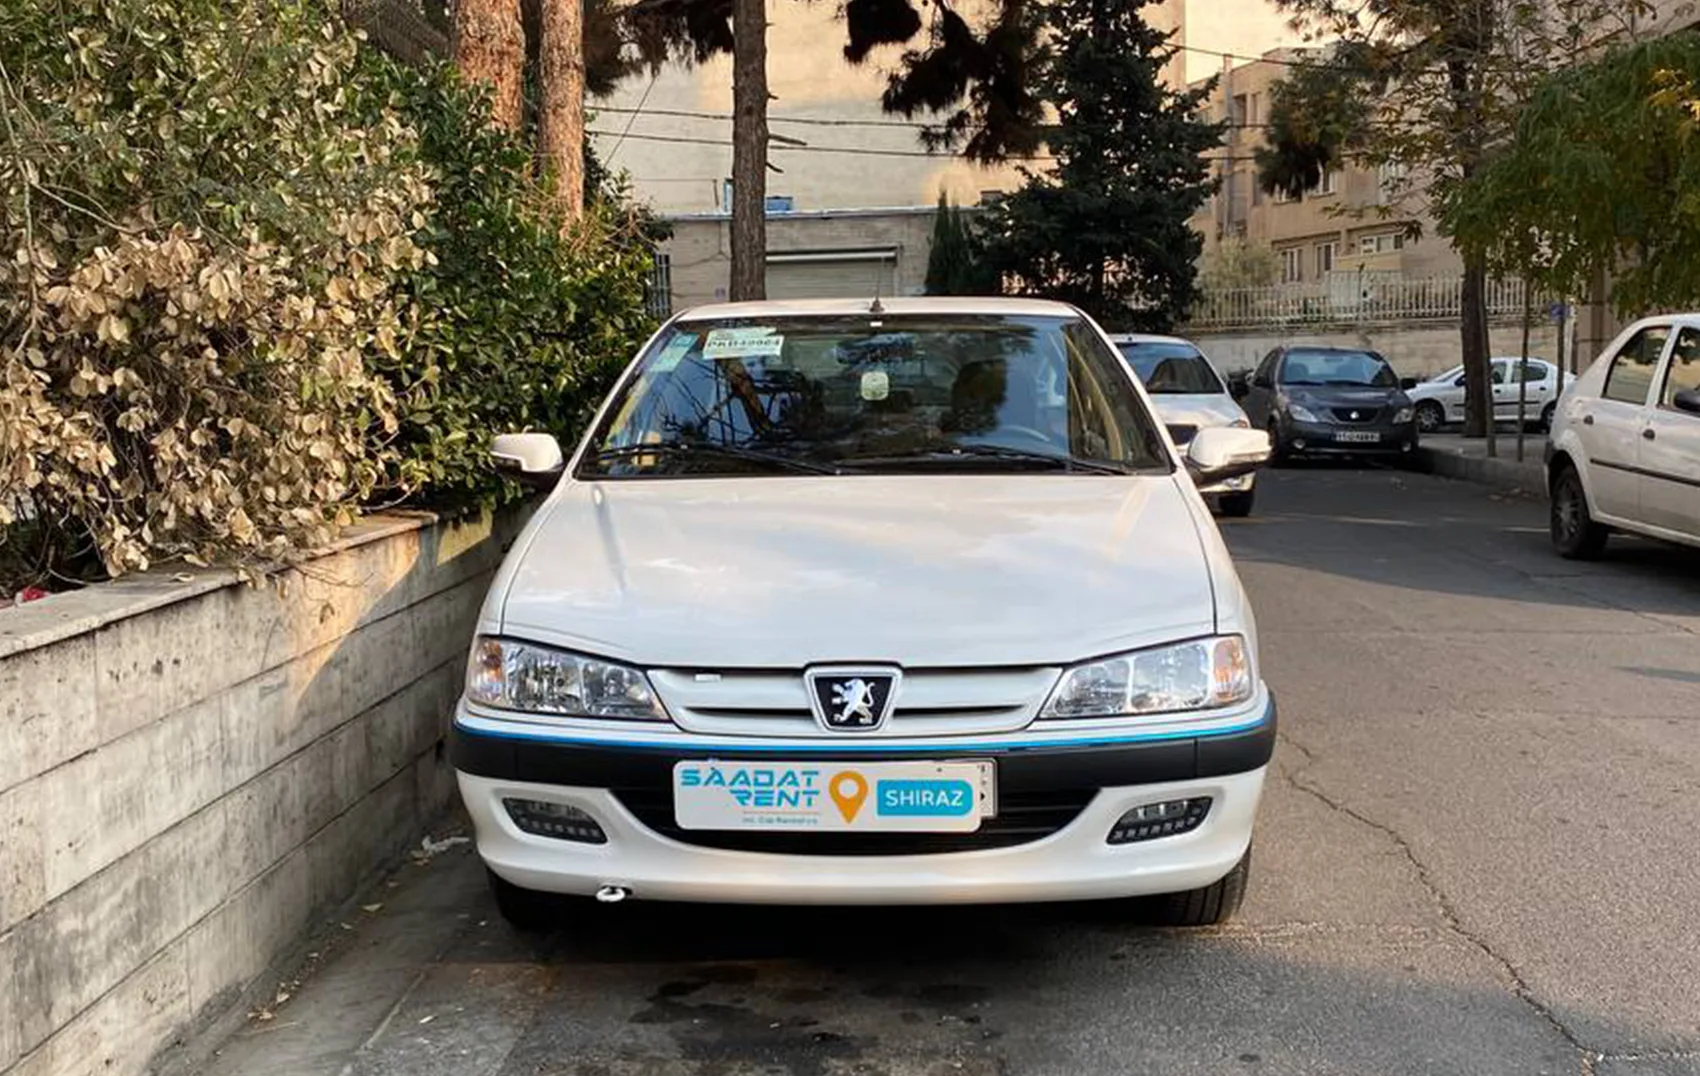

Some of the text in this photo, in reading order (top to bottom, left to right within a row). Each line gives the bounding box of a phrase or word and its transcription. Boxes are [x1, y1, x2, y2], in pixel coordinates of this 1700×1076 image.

[681, 769, 820, 787] SAADAT
[729, 789, 820, 807] RENT
[885, 789, 964, 807] SHIRAZ
